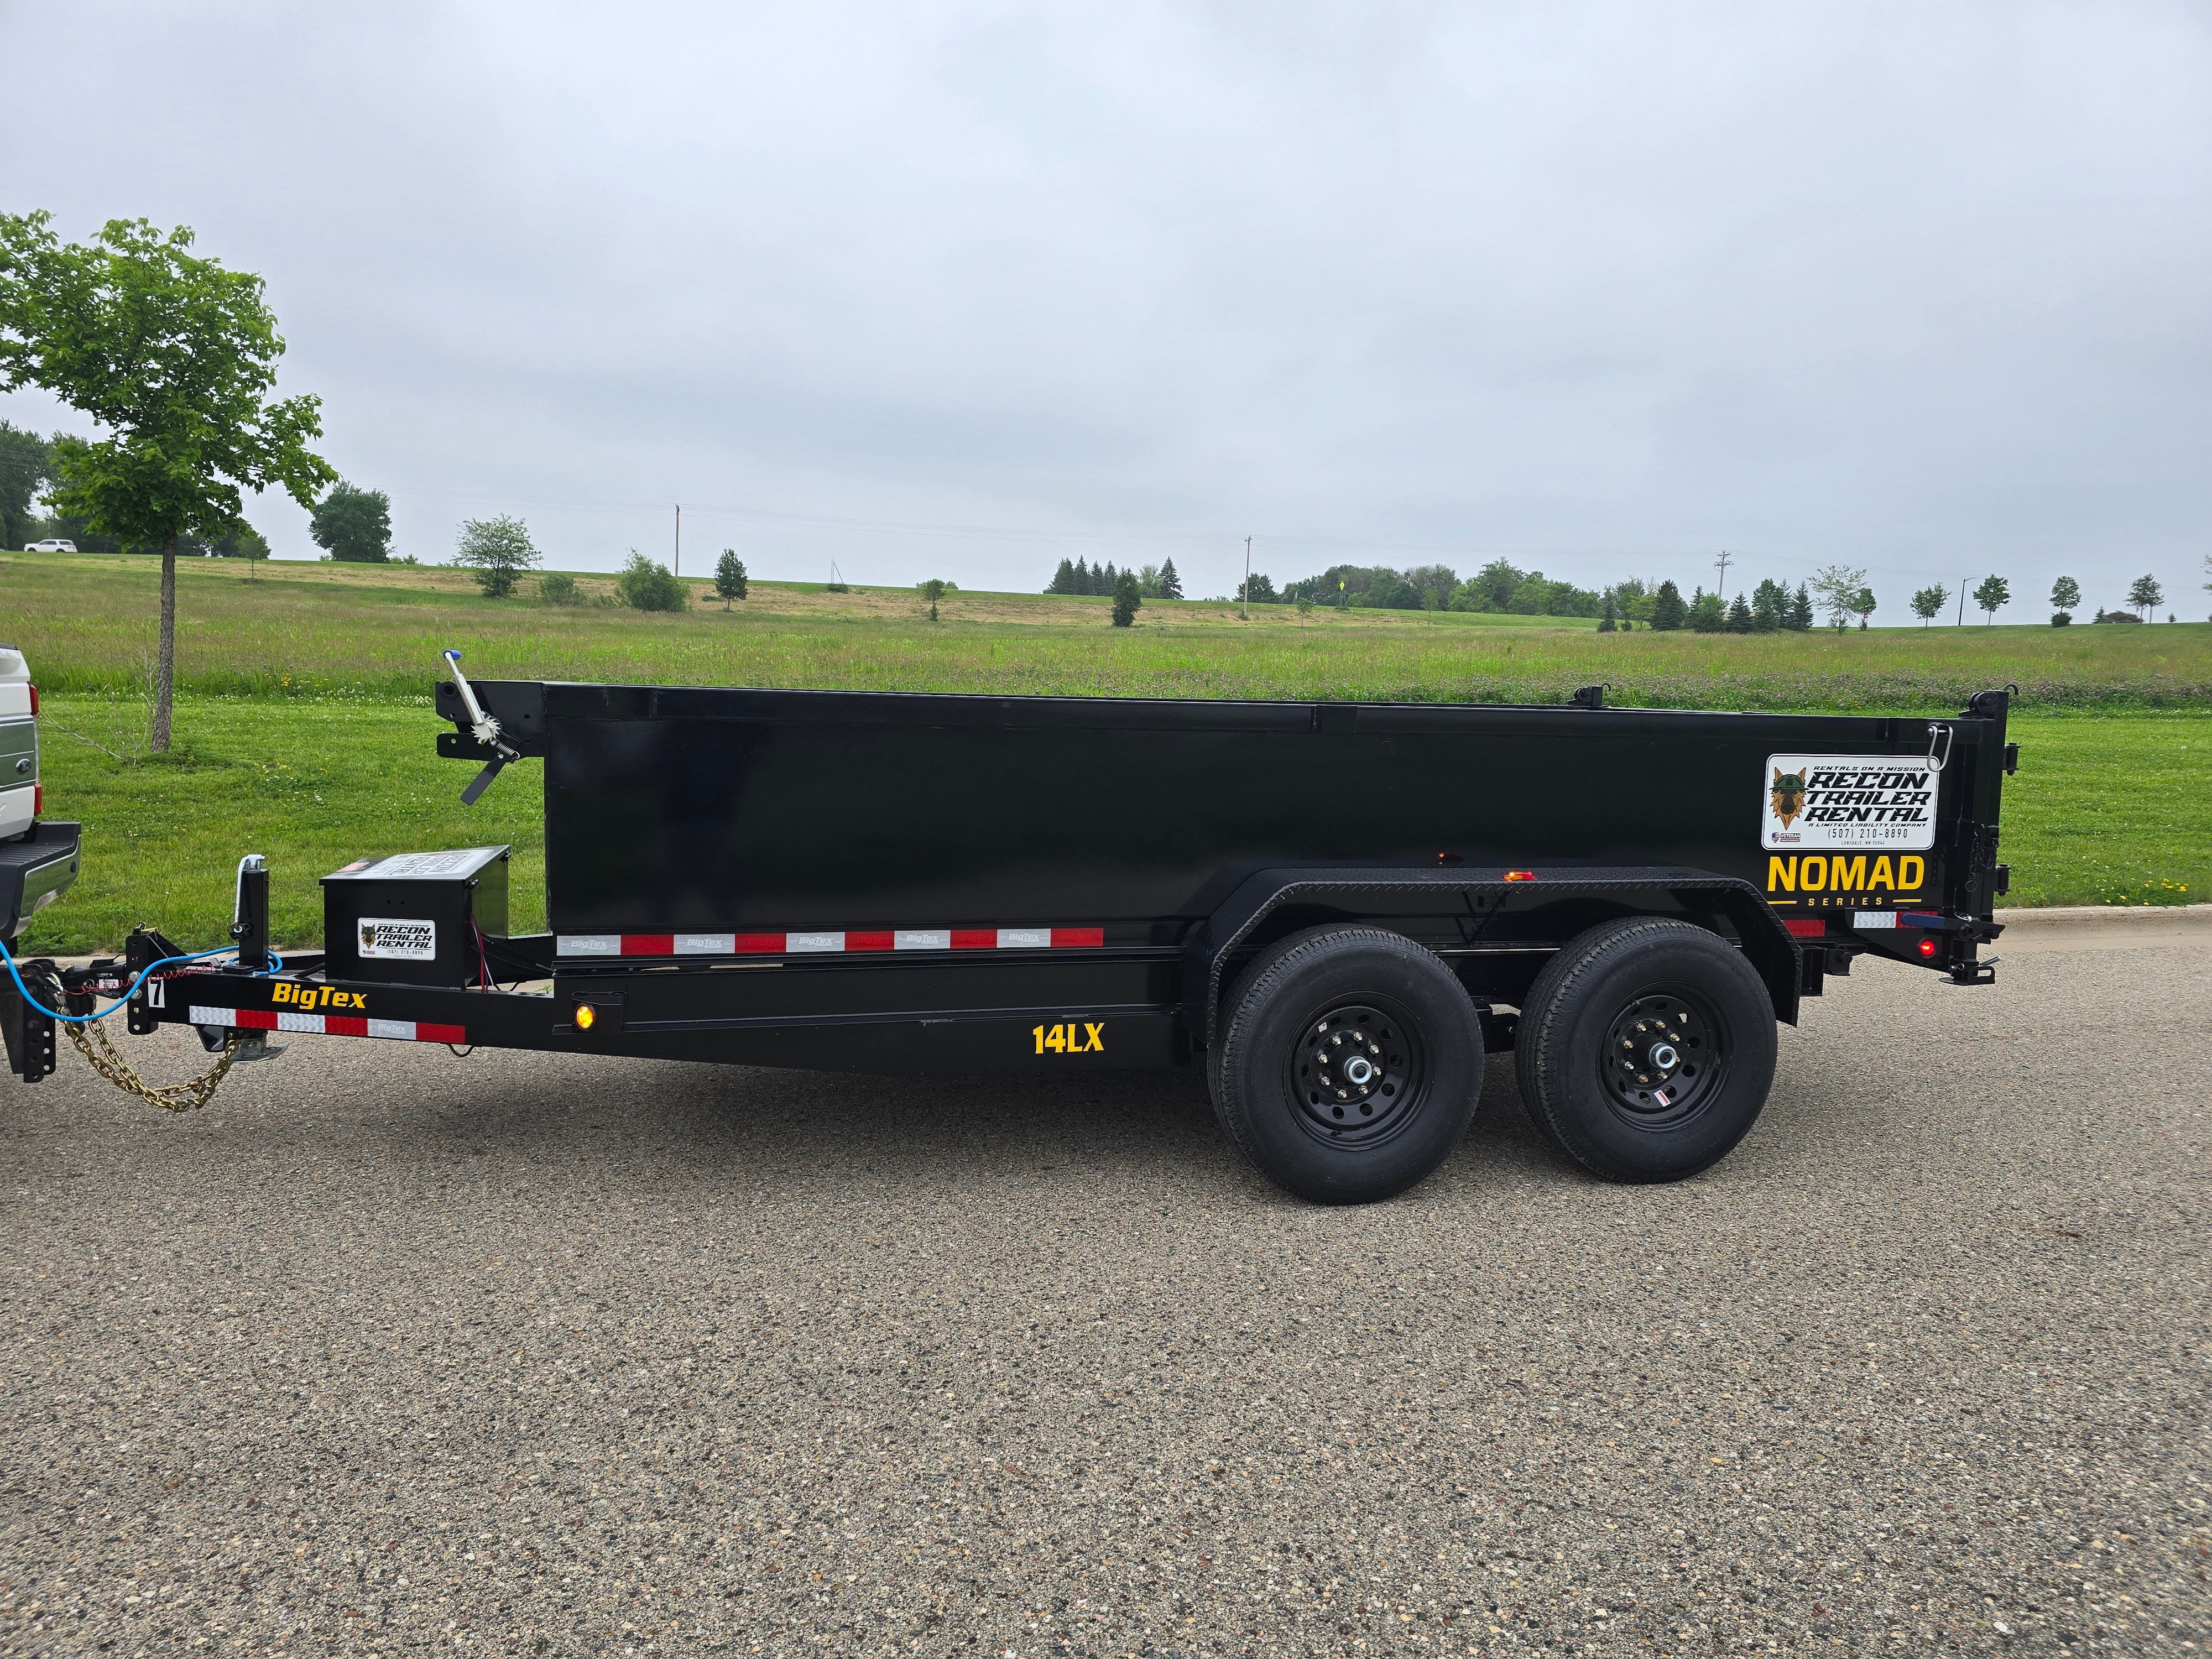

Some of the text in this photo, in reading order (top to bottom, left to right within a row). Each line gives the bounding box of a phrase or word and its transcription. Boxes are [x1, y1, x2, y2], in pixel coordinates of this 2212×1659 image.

[1807, 772, 1930, 789] RECON
[1806, 791, 1932, 805] TRAILER
[1804, 807, 1929, 822] RENTAL
[1828, 828, 1908, 839] (507) 210-8890
[1767, 855, 1924, 891] NOMAD
[1808, 897, 1882, 906] SERIES
[376, 926, 431, 935] RECON
[1008, 932, 1040, 941] BigTex
[799, 936, 833, 946] BigTex
[906, 934, 939, 943] BigTex
[150, 979, 161, 1005] 7
[272, 983, 368, 1010] BigTex
[378, 1024, 406, 1032] BigTex
[1032, 1022, 1105, 1054] 14LX
